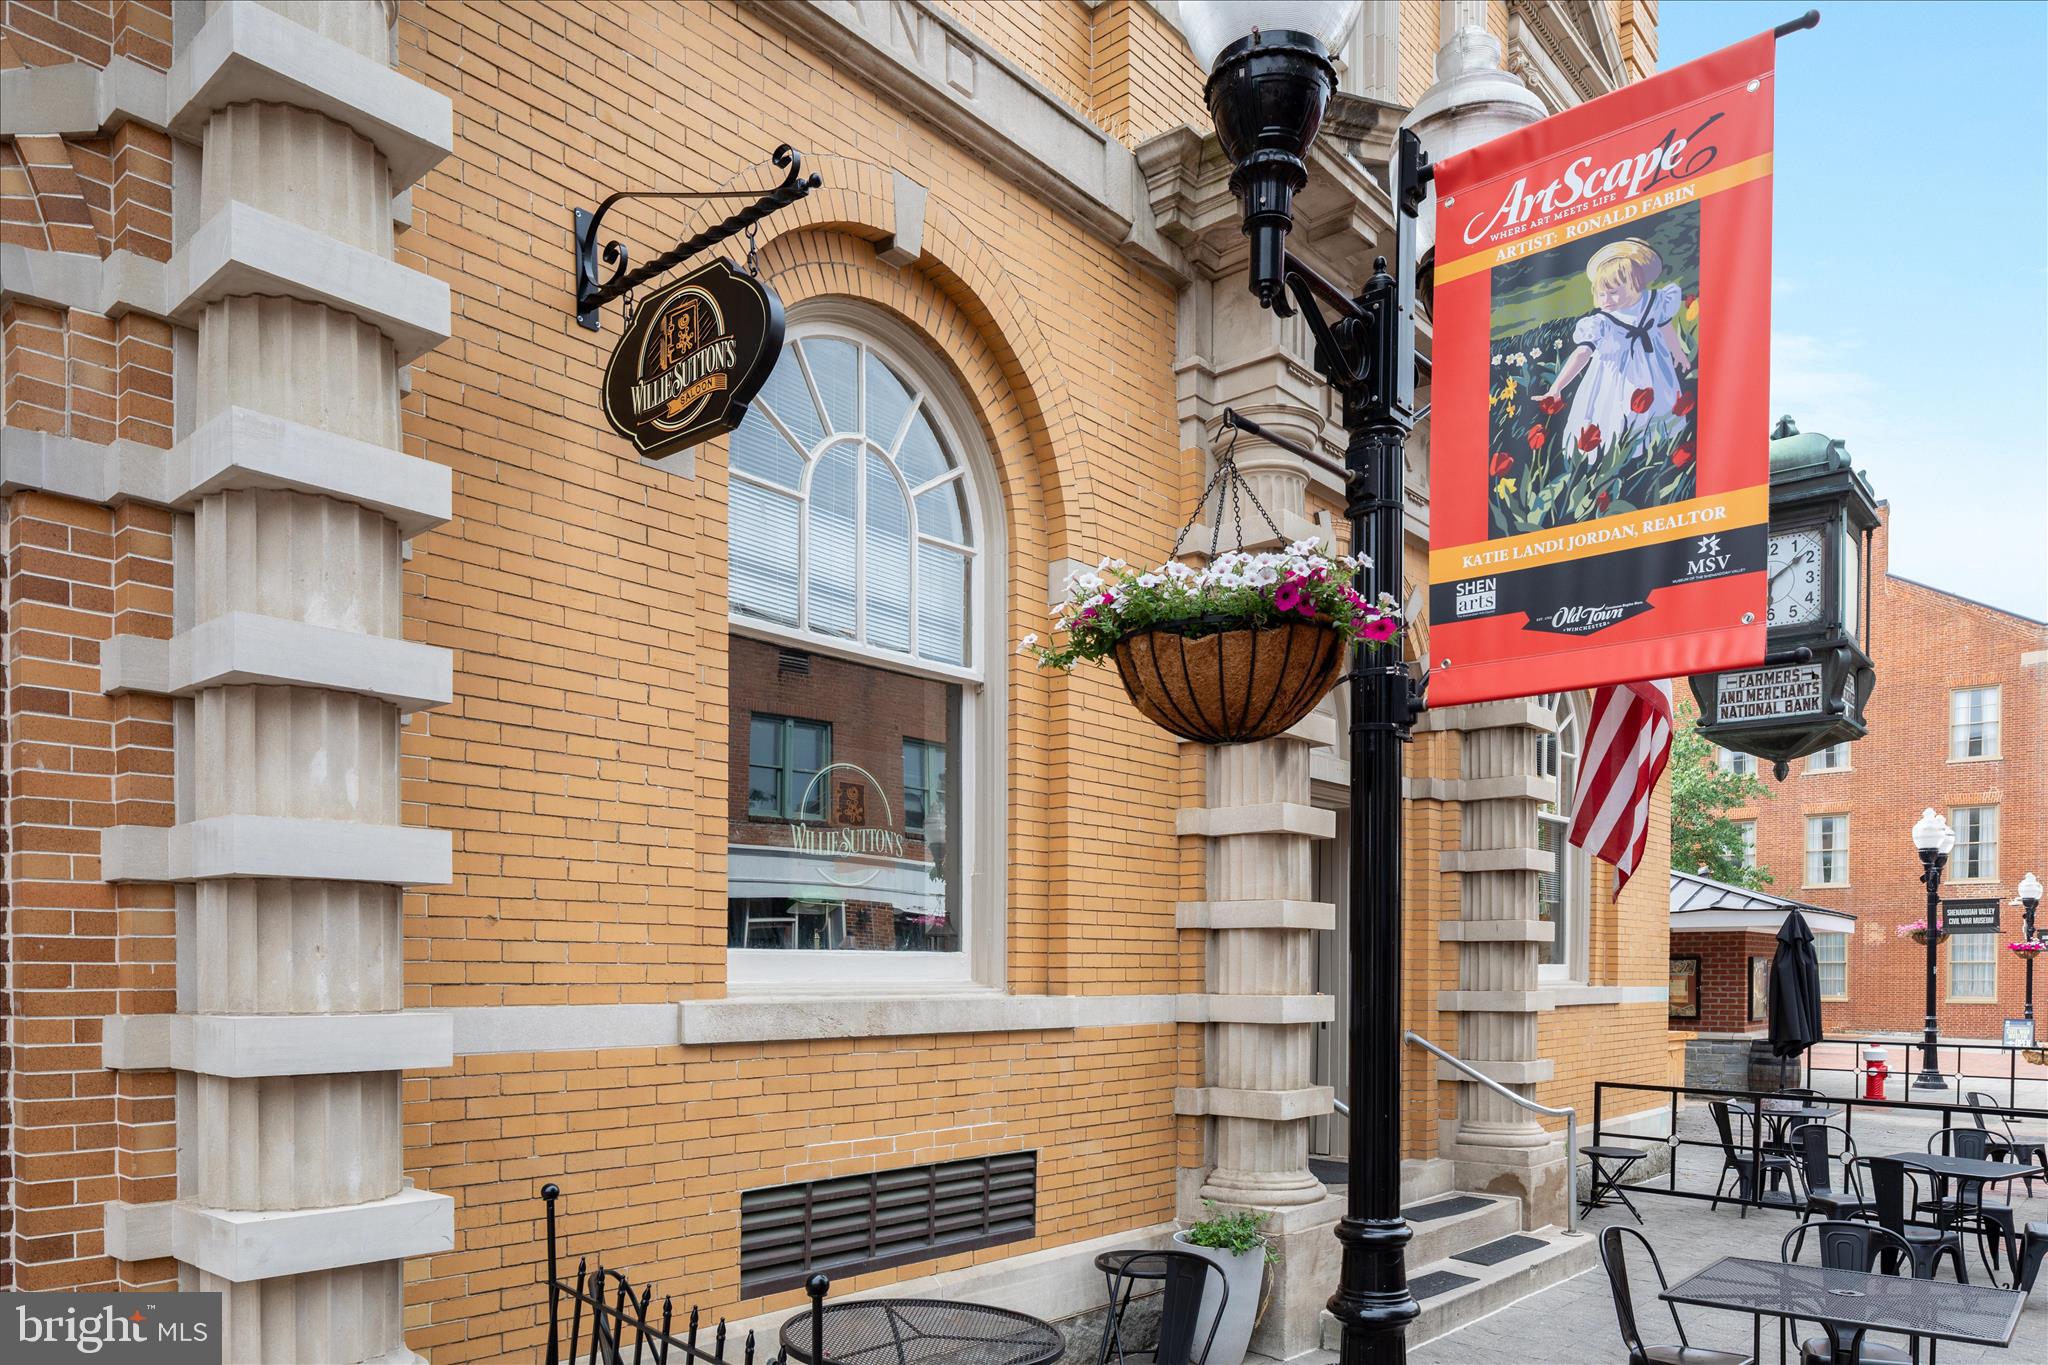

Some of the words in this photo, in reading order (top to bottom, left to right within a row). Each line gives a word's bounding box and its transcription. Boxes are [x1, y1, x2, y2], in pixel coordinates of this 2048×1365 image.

[845, 0, 979, 100] ND
[1463, 138, 1687, 245] ArtScape
[1490, 224, 1527, 242] WHERE
[1530, 215, 1551, 229] ART
[1554, 202, 1589, 222] MEETS
[1592, 192, 1617, 208] LIFE
[1495, 231, 1559, 262] ARTIST:
[1565, 204, 1638, 240] RONALD
[1641, 184, 1696, 213] FABIN
[631, 372, 673, 415] WILLIE
[672, 340, 737, 398] SUTTON'S
[679, 378, 714, 405] SALOON
[1462, 549, 1509, 568] KATIE
[1512, 538, 1564, 560] LANDI
[1566, 524, 1638, 552] JORDAN,
[1642, 505, 1728, 534] REALTOR
[1686, 554, 1732, 575] MSV
[1456, 577, 1497, 596] SHEN
[1805, 570, 1815, 584] 3
[1458, 595, 1494, 612] arts
[1804, 591, 1815, 604] 4
[1551, 605, 1584, 628] Old
[1582, 603, 1624, 625] Town
[1788, 605, 1798, 618] 5
[1566, 622, 1607, 632] WINCHESTER
[1739, 668, 1800, 688] FARMERS
[1719, 690, 1743, 705] AND
[1746, 682, 1820, 702] MERCHANTS
[1720, 702, 1781, 719] NATIONAL
[1784, 697, 1820, 713] BANK
[791, 822, 839, 856] WILLIE
[840, 827, 903, 858] SUTTON'S
